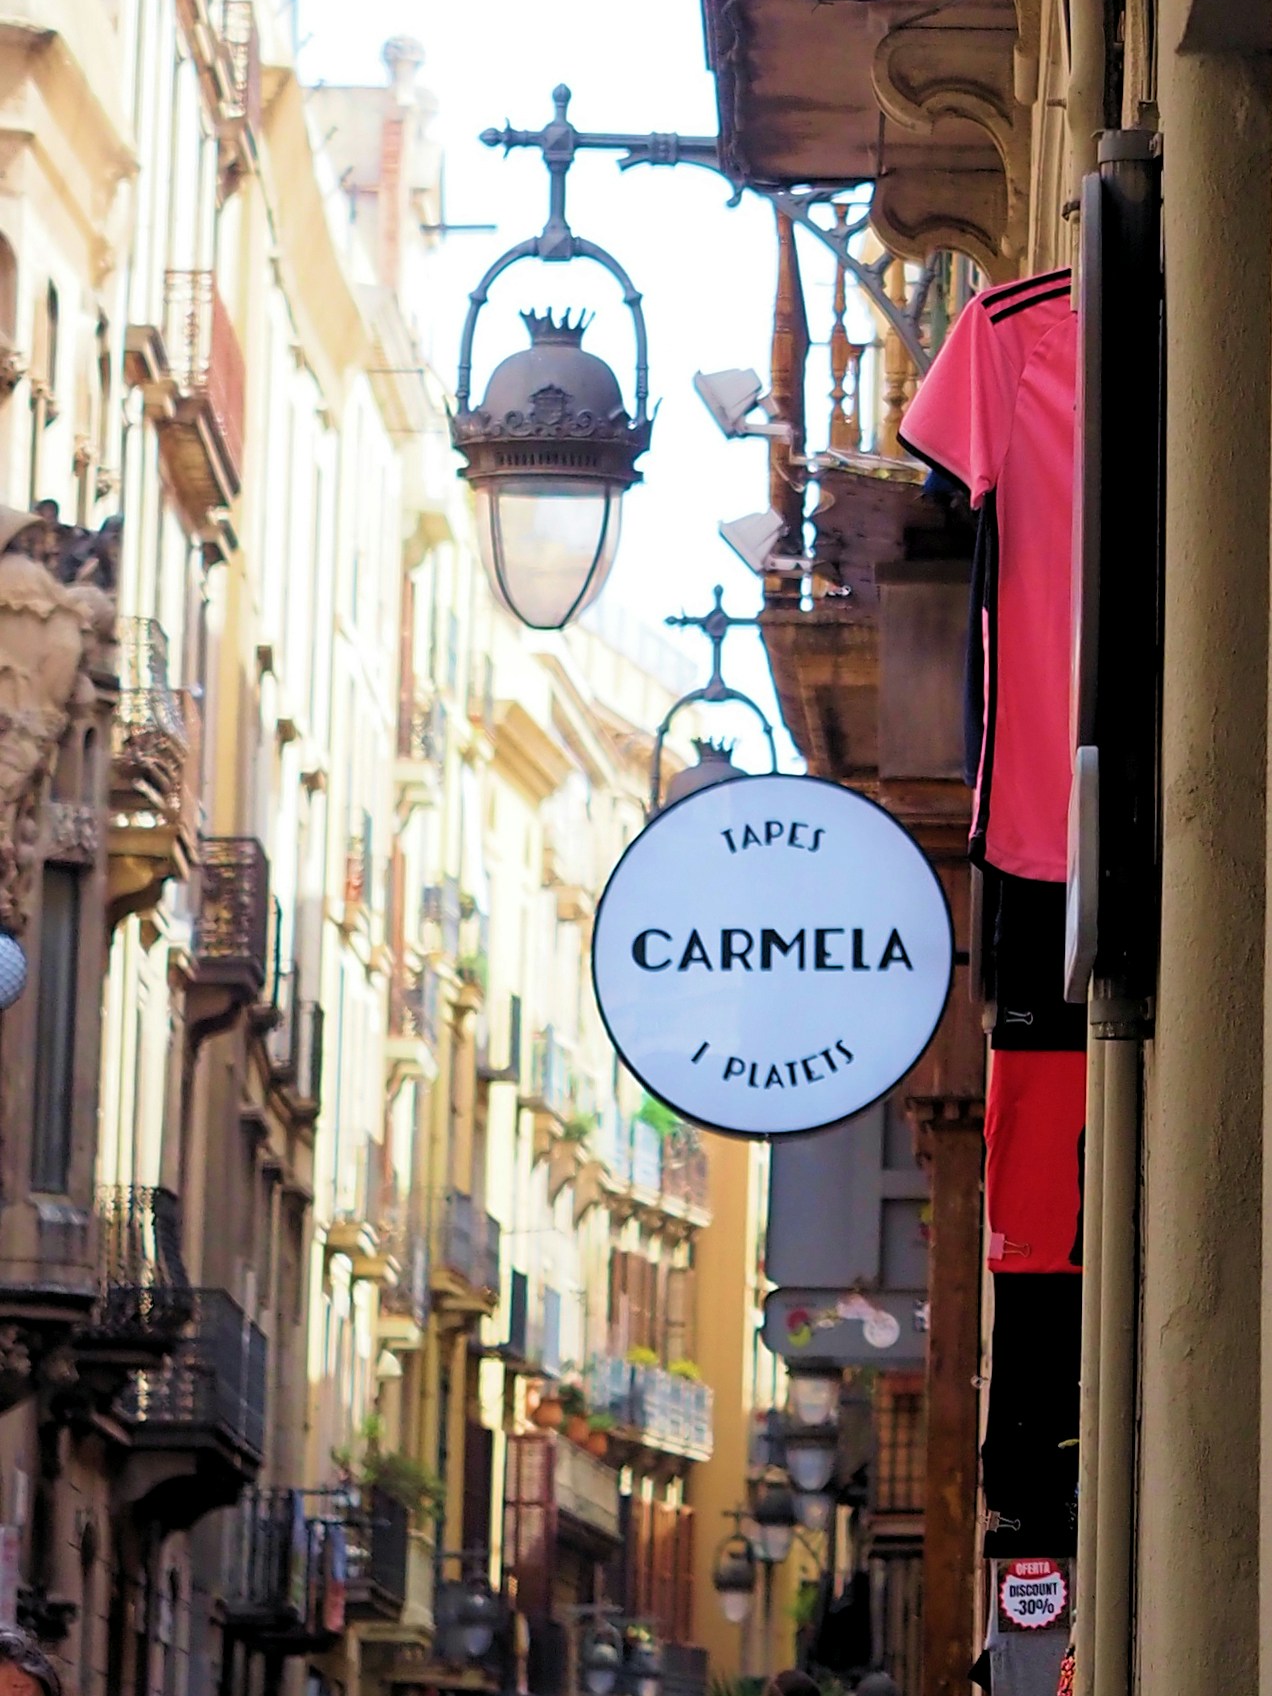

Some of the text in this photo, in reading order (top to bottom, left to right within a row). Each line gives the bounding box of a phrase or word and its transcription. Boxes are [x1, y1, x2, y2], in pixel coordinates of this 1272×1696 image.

[720, 820, 826, 854] TAPES
[631, 927, 914, 972] CARMELA
[721, 1039, 856, 1090] PLATETS
[1015, 1561, 1051, 1576] OFERTA
[1009, 1582, 1057, 1597] DISCOUNT
[1013, 1598, 1055, 1616] -30%
